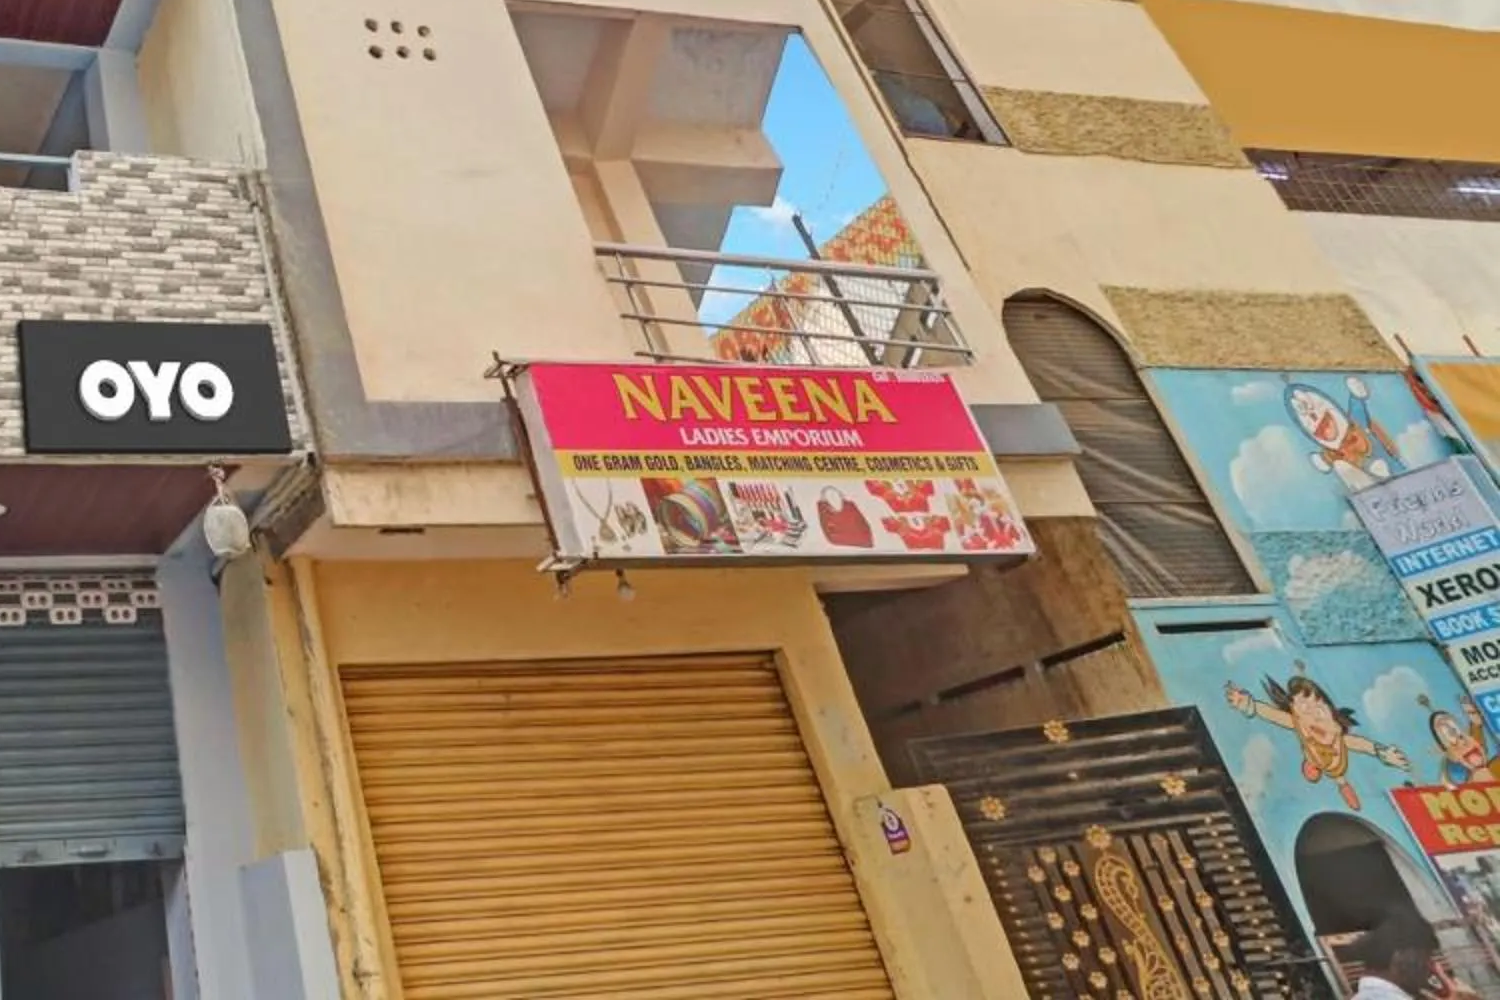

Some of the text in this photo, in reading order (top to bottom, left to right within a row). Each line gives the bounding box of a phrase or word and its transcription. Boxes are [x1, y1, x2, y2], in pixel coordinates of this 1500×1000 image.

[79, 359, 235, 421] OYO
[611, 373, 899, 425] NAVEENA
[679, 427, 864, 448] LADIES EMPORIUM
[573, 455, 600, 471] ONE
[602, 455, 641, 471] GRAM
[747, 455, 812, 472] MATCHING
[865, 456, 933, 472] COSMETICS
[934, 456, 945, 471] &
[947, 456, 979, 472] GIFTS
[1396, 529, 1500, 574] INTERNET
[1434, 609, 1484, 638] BOOK
[1461, 638, 1500, 666] MO
[1468, 663, 1500, 684] ACC
